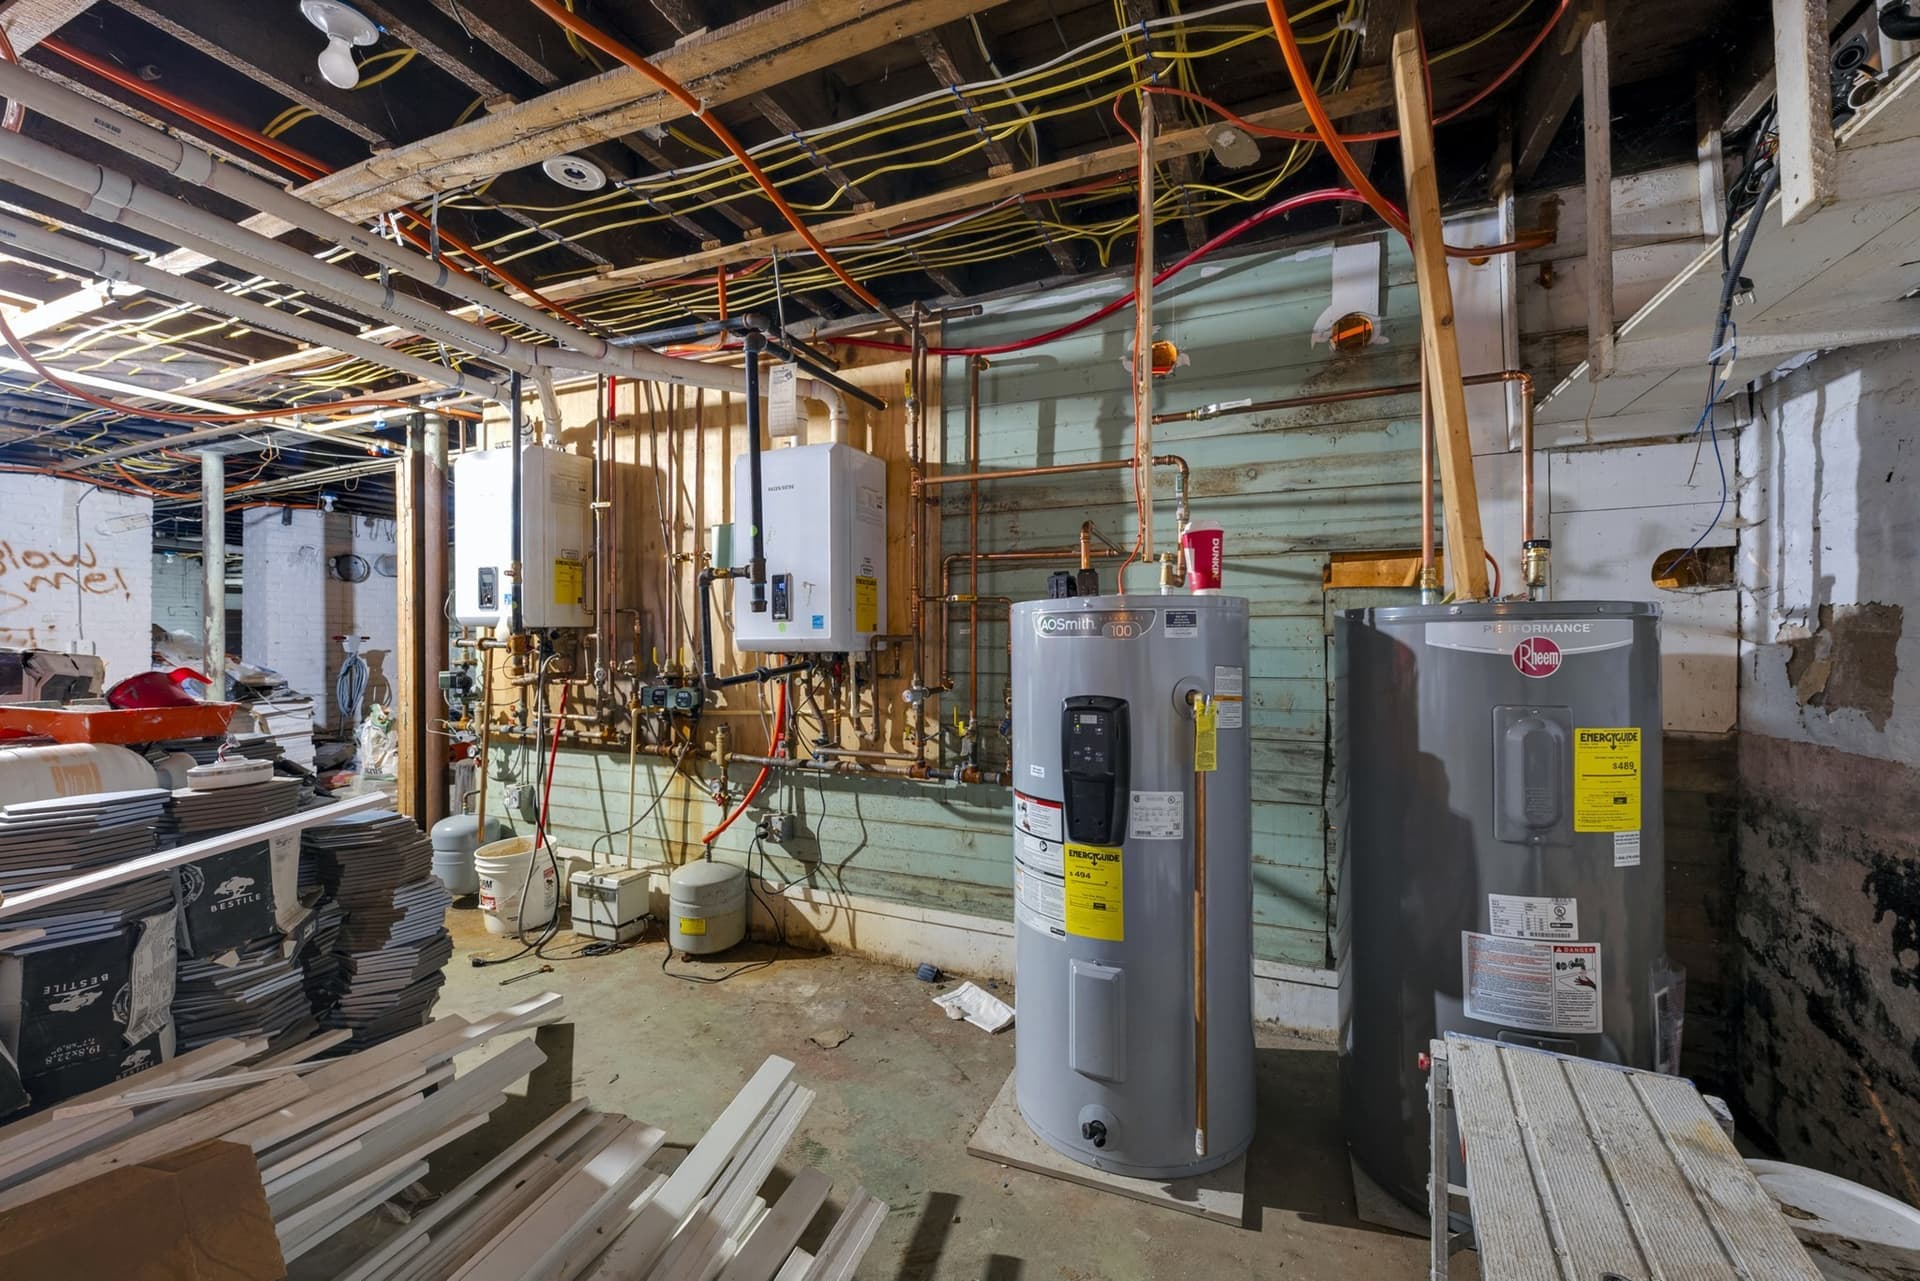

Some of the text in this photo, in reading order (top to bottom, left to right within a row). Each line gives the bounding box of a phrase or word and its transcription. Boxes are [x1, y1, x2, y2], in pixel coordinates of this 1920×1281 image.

[24, 568, 130, 602] me!
[1111, 624, 1132, 637] 100
[1519, 637, 1559, 671] Rheem
[210, 893, 261, 913] BESTILE
[43, 973, 109, 995] BESTILE
